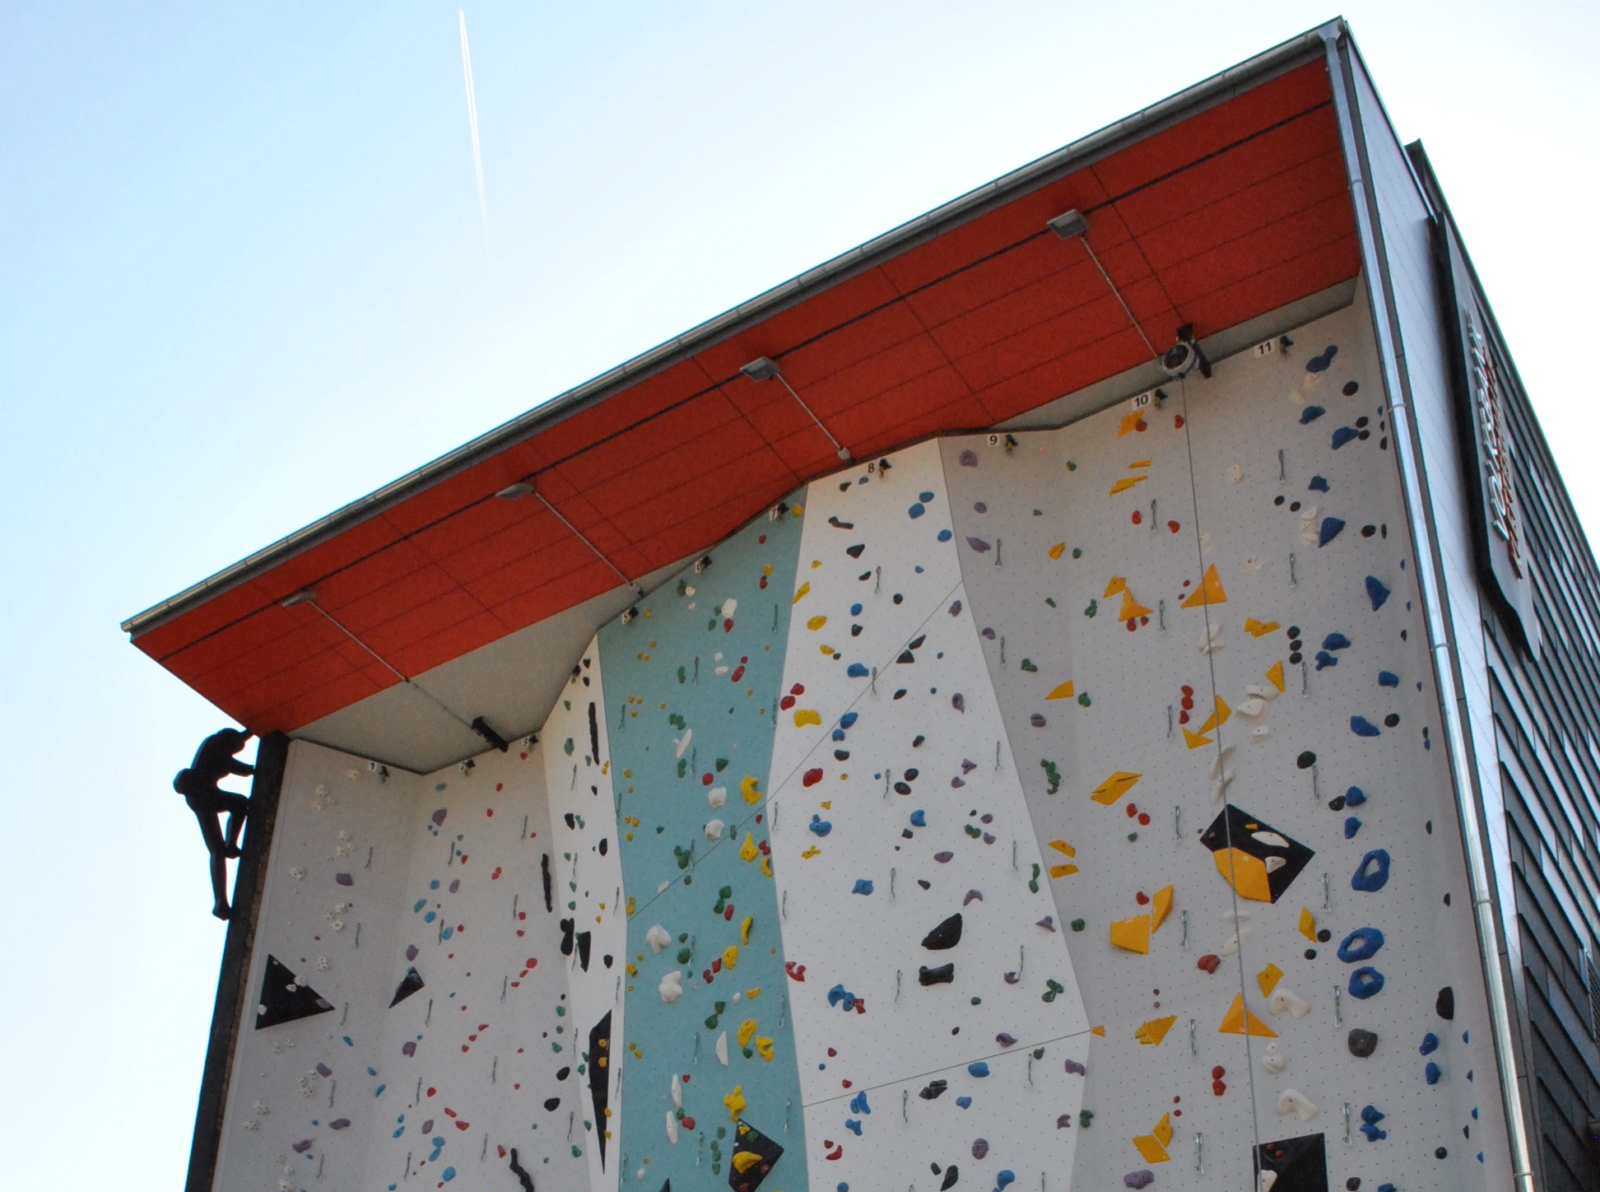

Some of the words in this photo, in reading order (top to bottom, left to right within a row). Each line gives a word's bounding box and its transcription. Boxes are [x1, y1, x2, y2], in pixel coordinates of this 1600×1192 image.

[1258, 341, 1271, 355] 11
[1135, 394, 1149, 407] 10
[989, 434, 998, 446] 9
[867, 462, 875, 474] 8
